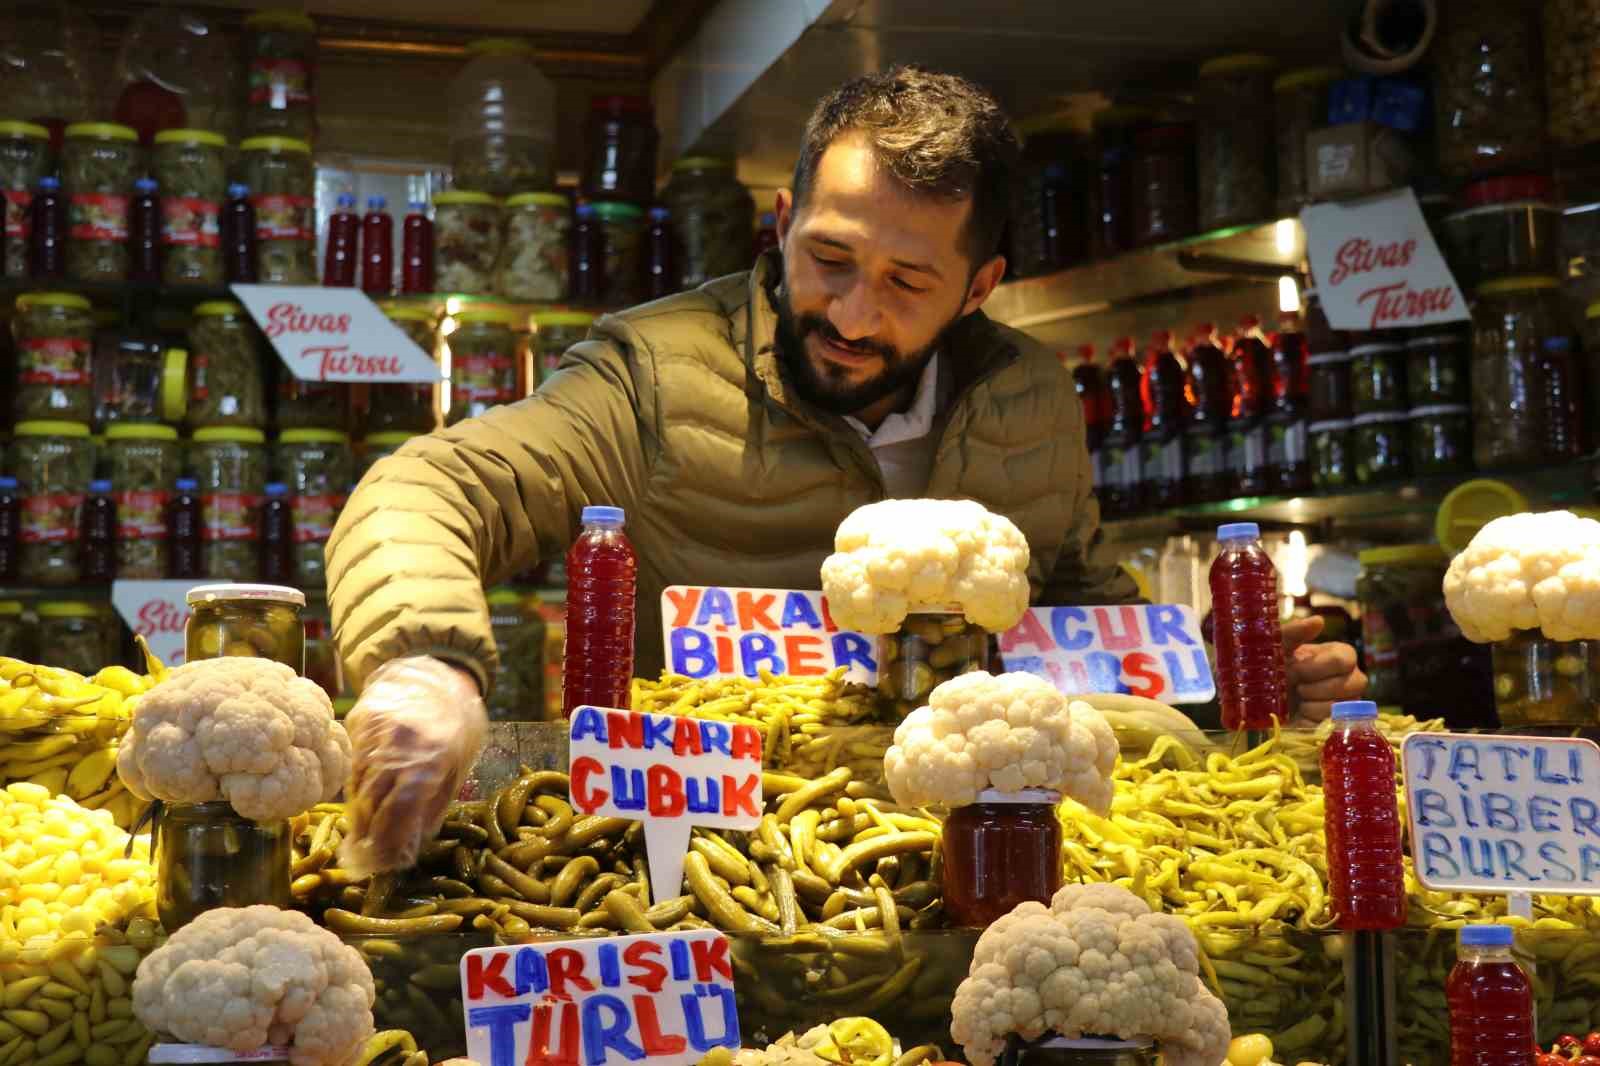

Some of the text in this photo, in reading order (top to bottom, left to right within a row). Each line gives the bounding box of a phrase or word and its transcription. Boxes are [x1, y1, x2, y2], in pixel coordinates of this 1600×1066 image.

[1329, 237, 1417, 286] Sivas
[264, 301, 351, 337] Sivas
[665, 587, 863, 632] YAKA
[1000, 604, 1197, 652] ACUR
[571, 707, 762, 762] ANKARA
[1413, 740, 1583, 785] TATLI
[571, 756, 761, 818] ÇUBUK
